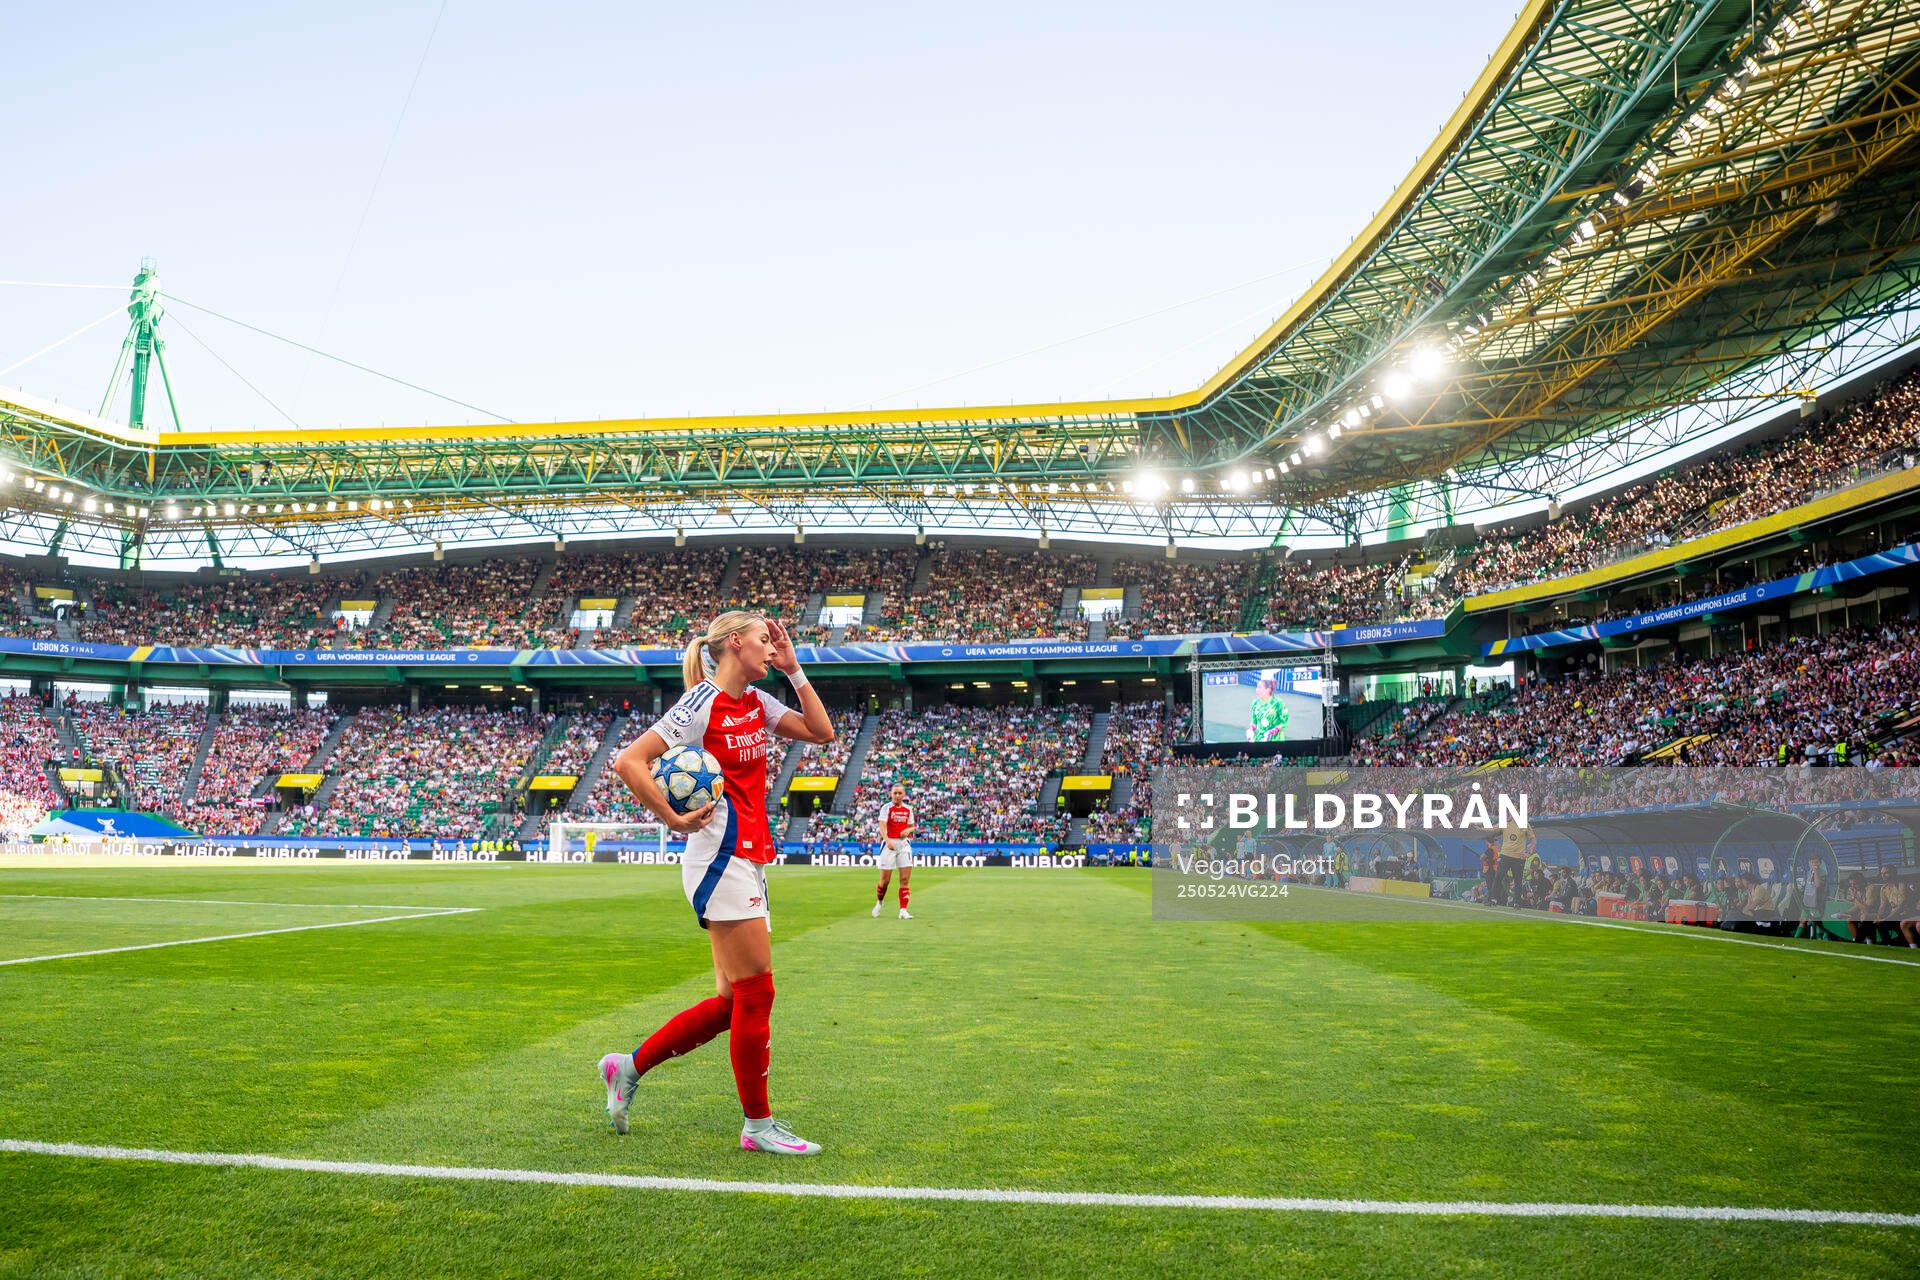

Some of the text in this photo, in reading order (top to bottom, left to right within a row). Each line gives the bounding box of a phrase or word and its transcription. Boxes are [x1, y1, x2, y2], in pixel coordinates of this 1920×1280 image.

[1640, 592, 1747, 625] UEFA WOMEN'S CHAMPIONS LEAGUE
[1355, 626, 1418, 640] LISBON 25 FINAL
[32, 641, 95, 654] LISBON 25 FINAL
[965, 644, 1118, 656] UEFA WOMEN'S CHAMPIONS LEAGUE
[317, 653, 456, 661] UEFA WOMEN'S CHAMPIONS LEAGUE
[1292, 671, 1313, 681] 27:22
[739, 748, 751, 763] FLY
[103, 843, 165, 857] HUBLOT
[174, 845, 237, 858] HUBLOT
[256, 847, 320, 859] HUBLOT
[345, 849, 411, 861] HUBLOT
[432, 850, 499, 862] HUBLOT
[913, 855, 987, 868] HUBLOT
[1011, 854, 1086, 868] HUBLOT
